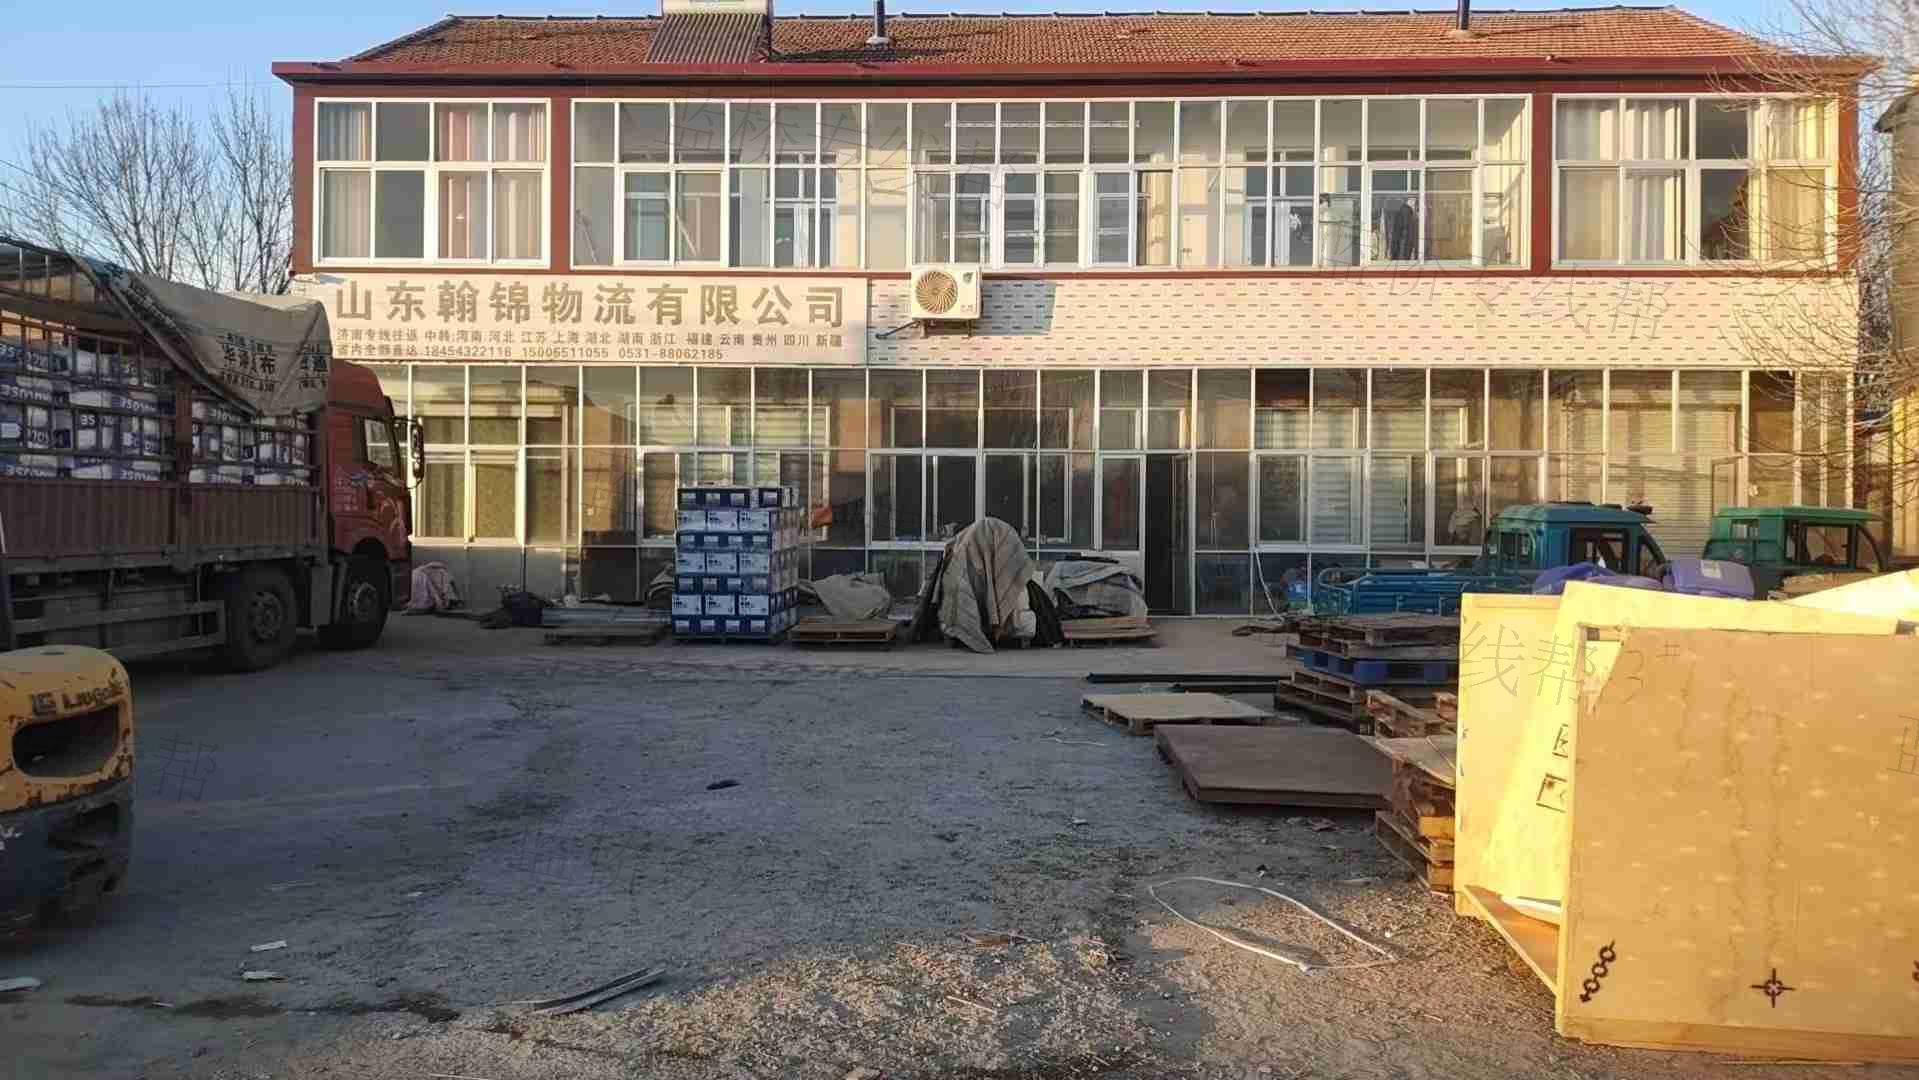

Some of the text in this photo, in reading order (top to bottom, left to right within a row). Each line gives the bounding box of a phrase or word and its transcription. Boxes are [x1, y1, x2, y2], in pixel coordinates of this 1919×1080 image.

[335, 280, 844, 328] 山东翰锦物流有限公司
[618, 347, 724, 360] 0531-88062185
